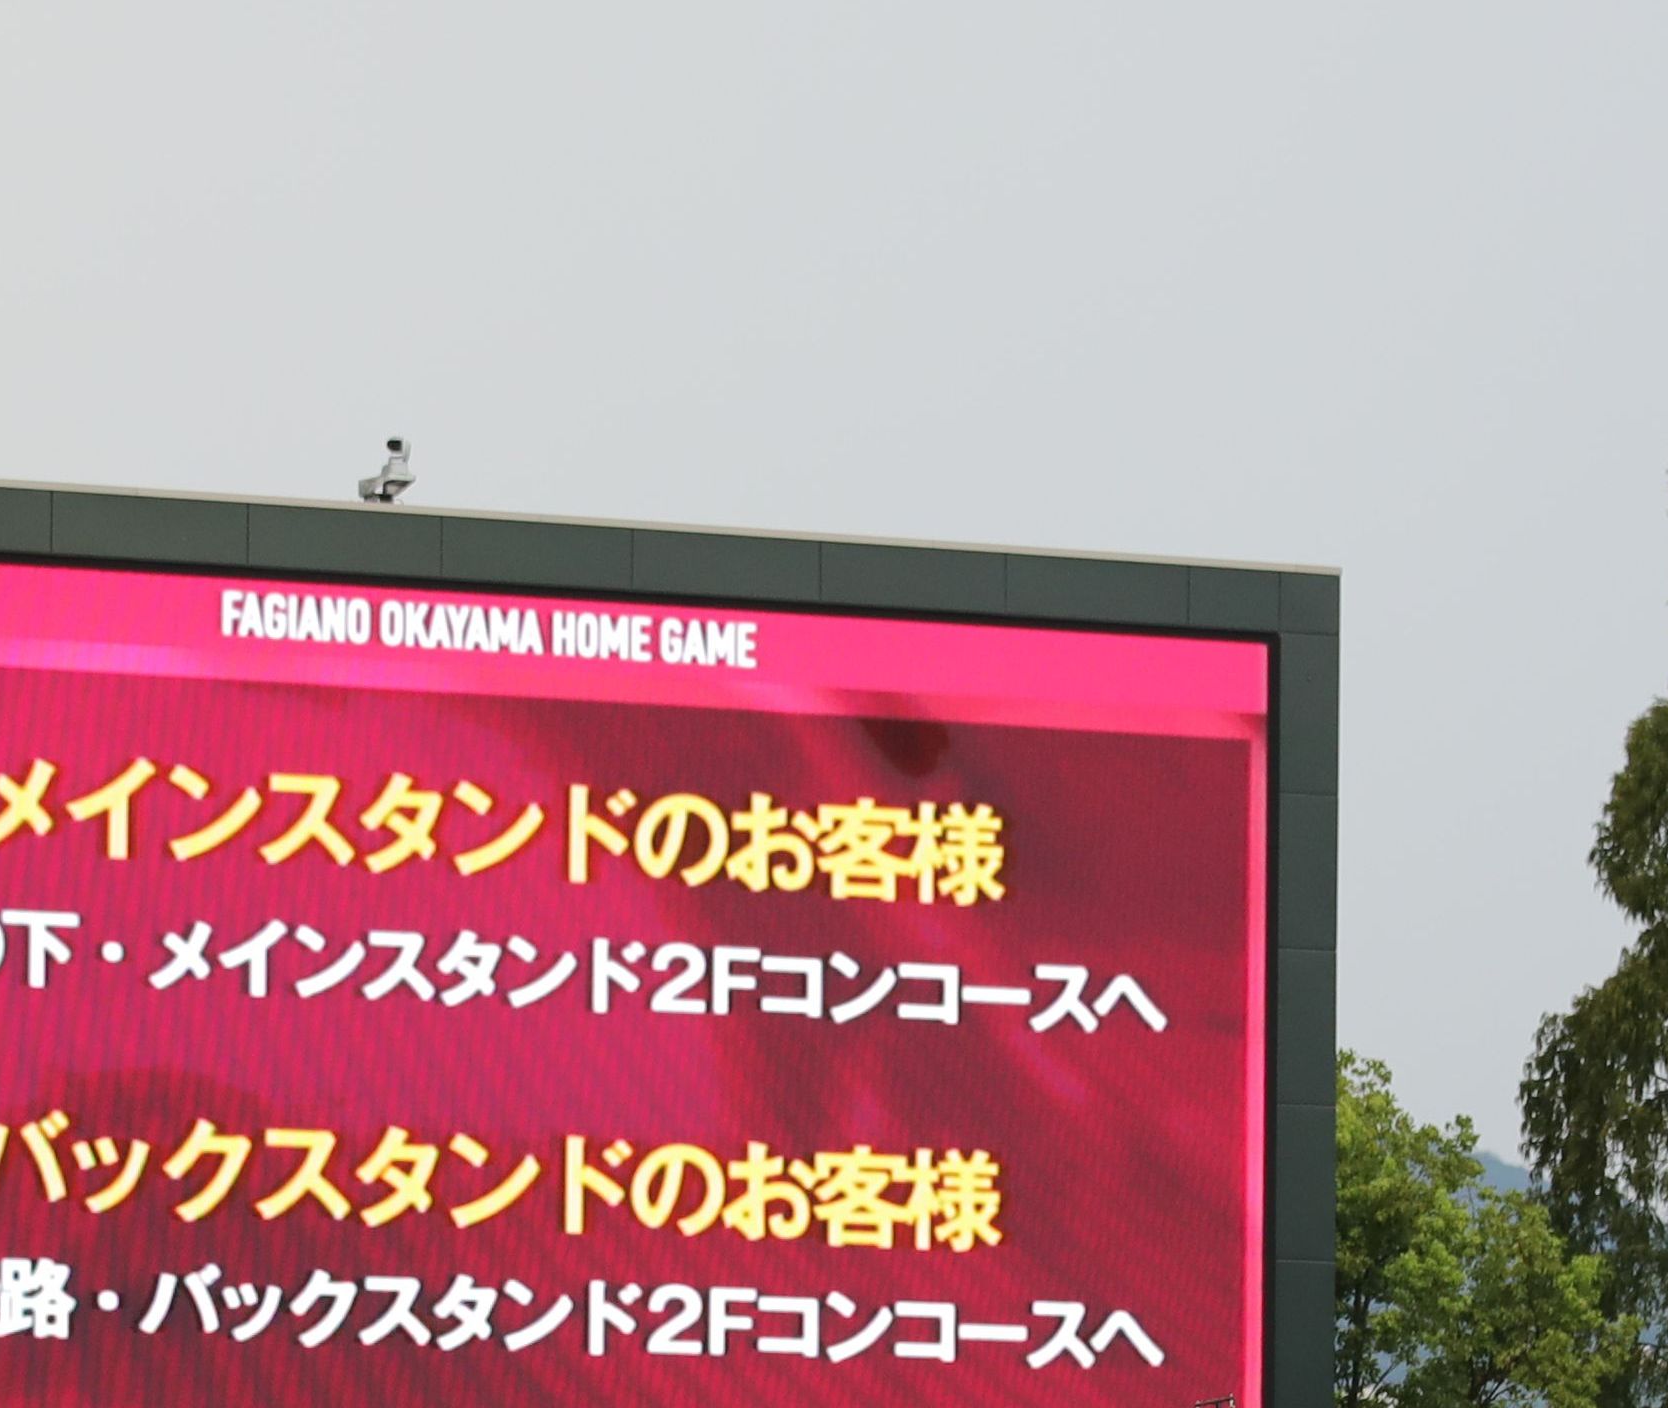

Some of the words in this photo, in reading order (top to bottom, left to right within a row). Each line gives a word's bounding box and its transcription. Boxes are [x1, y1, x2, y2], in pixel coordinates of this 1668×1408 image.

[220, 588, 373, 646] FAGIANO
[380, 598, 545, 656] OKAYAMA
[552, 612, 652, 664] HOME
[660, 619, 759, 671] GAME
